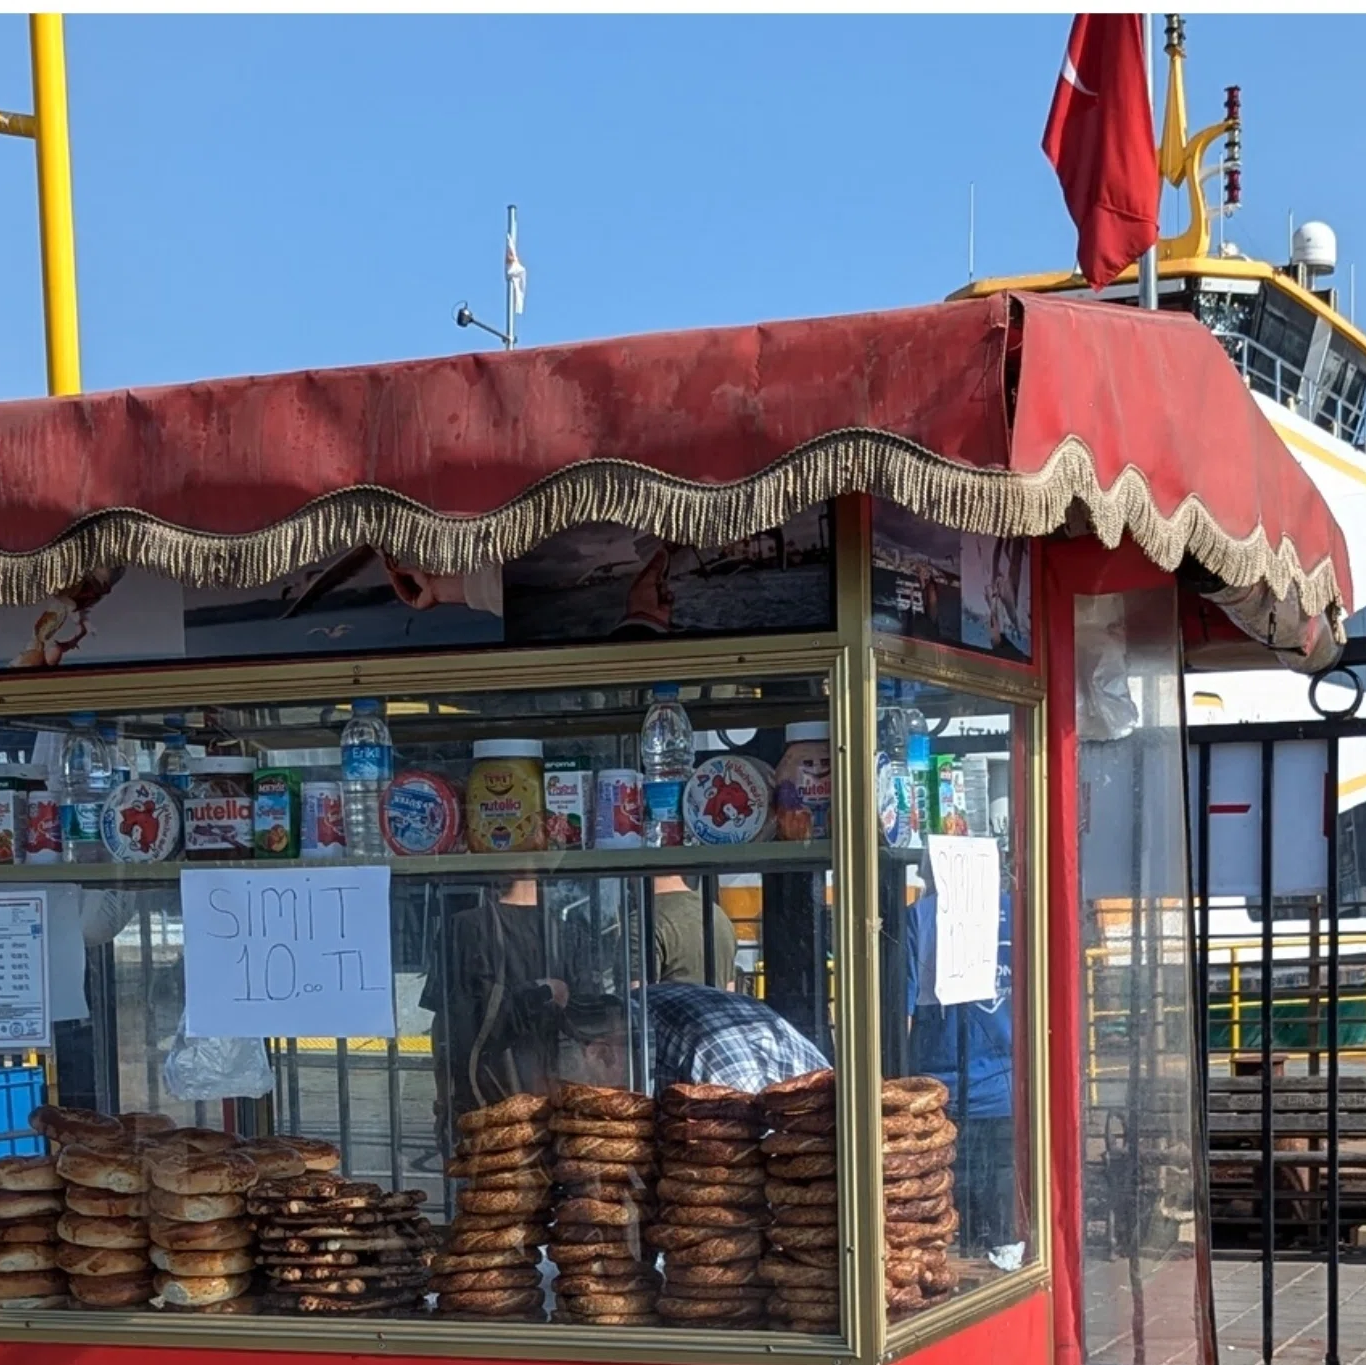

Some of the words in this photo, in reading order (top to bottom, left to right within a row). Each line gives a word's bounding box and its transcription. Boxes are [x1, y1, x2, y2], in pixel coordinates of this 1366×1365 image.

[185, 800, 252, 821] nutella
[480, 798, 522, 812] nutella
[207, 877, 360, 941] SİMİT
[322, 950, 386, 991] TL
